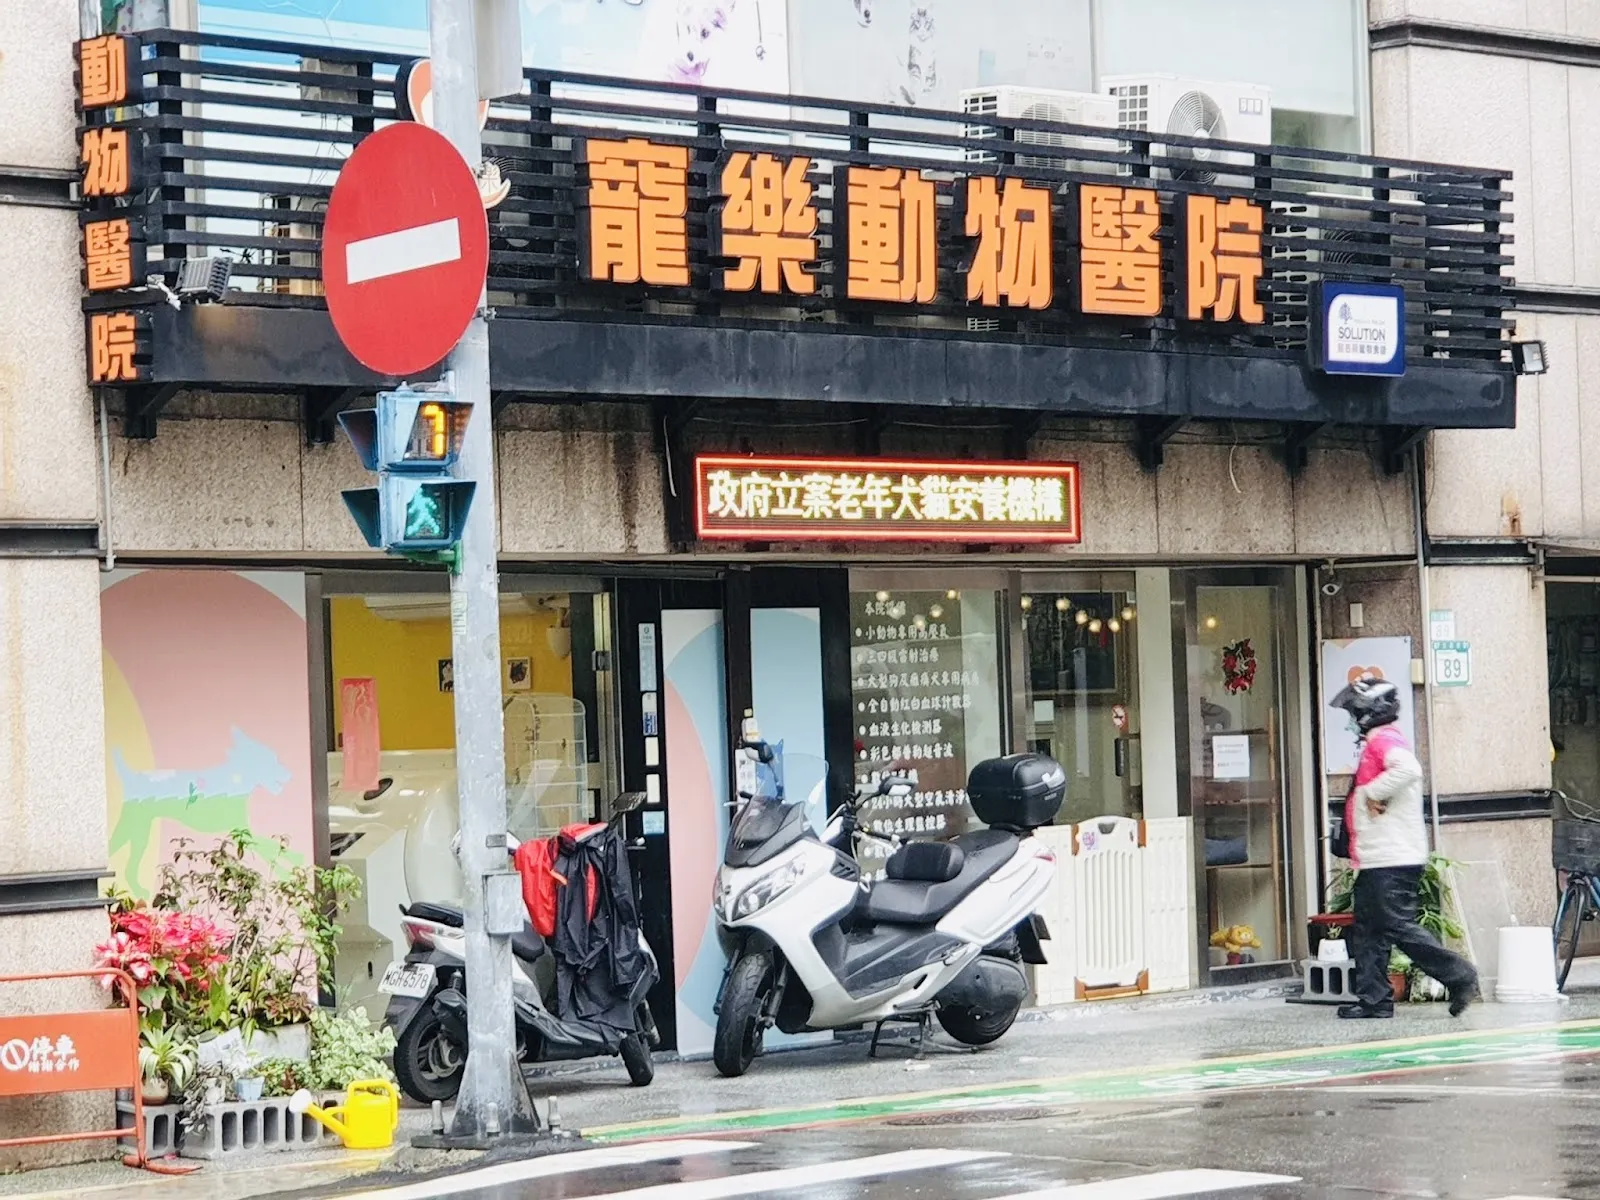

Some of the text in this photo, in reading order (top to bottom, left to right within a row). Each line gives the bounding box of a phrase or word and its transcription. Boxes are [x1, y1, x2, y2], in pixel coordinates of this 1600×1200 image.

[81, 34, 137, 382] 動物醫院
[586, 137, 1265, 324] 寵樂動物醫院
[1338, 327, 1386, 341] SOLUTION
[1444, 658, 1461, 679] 89
